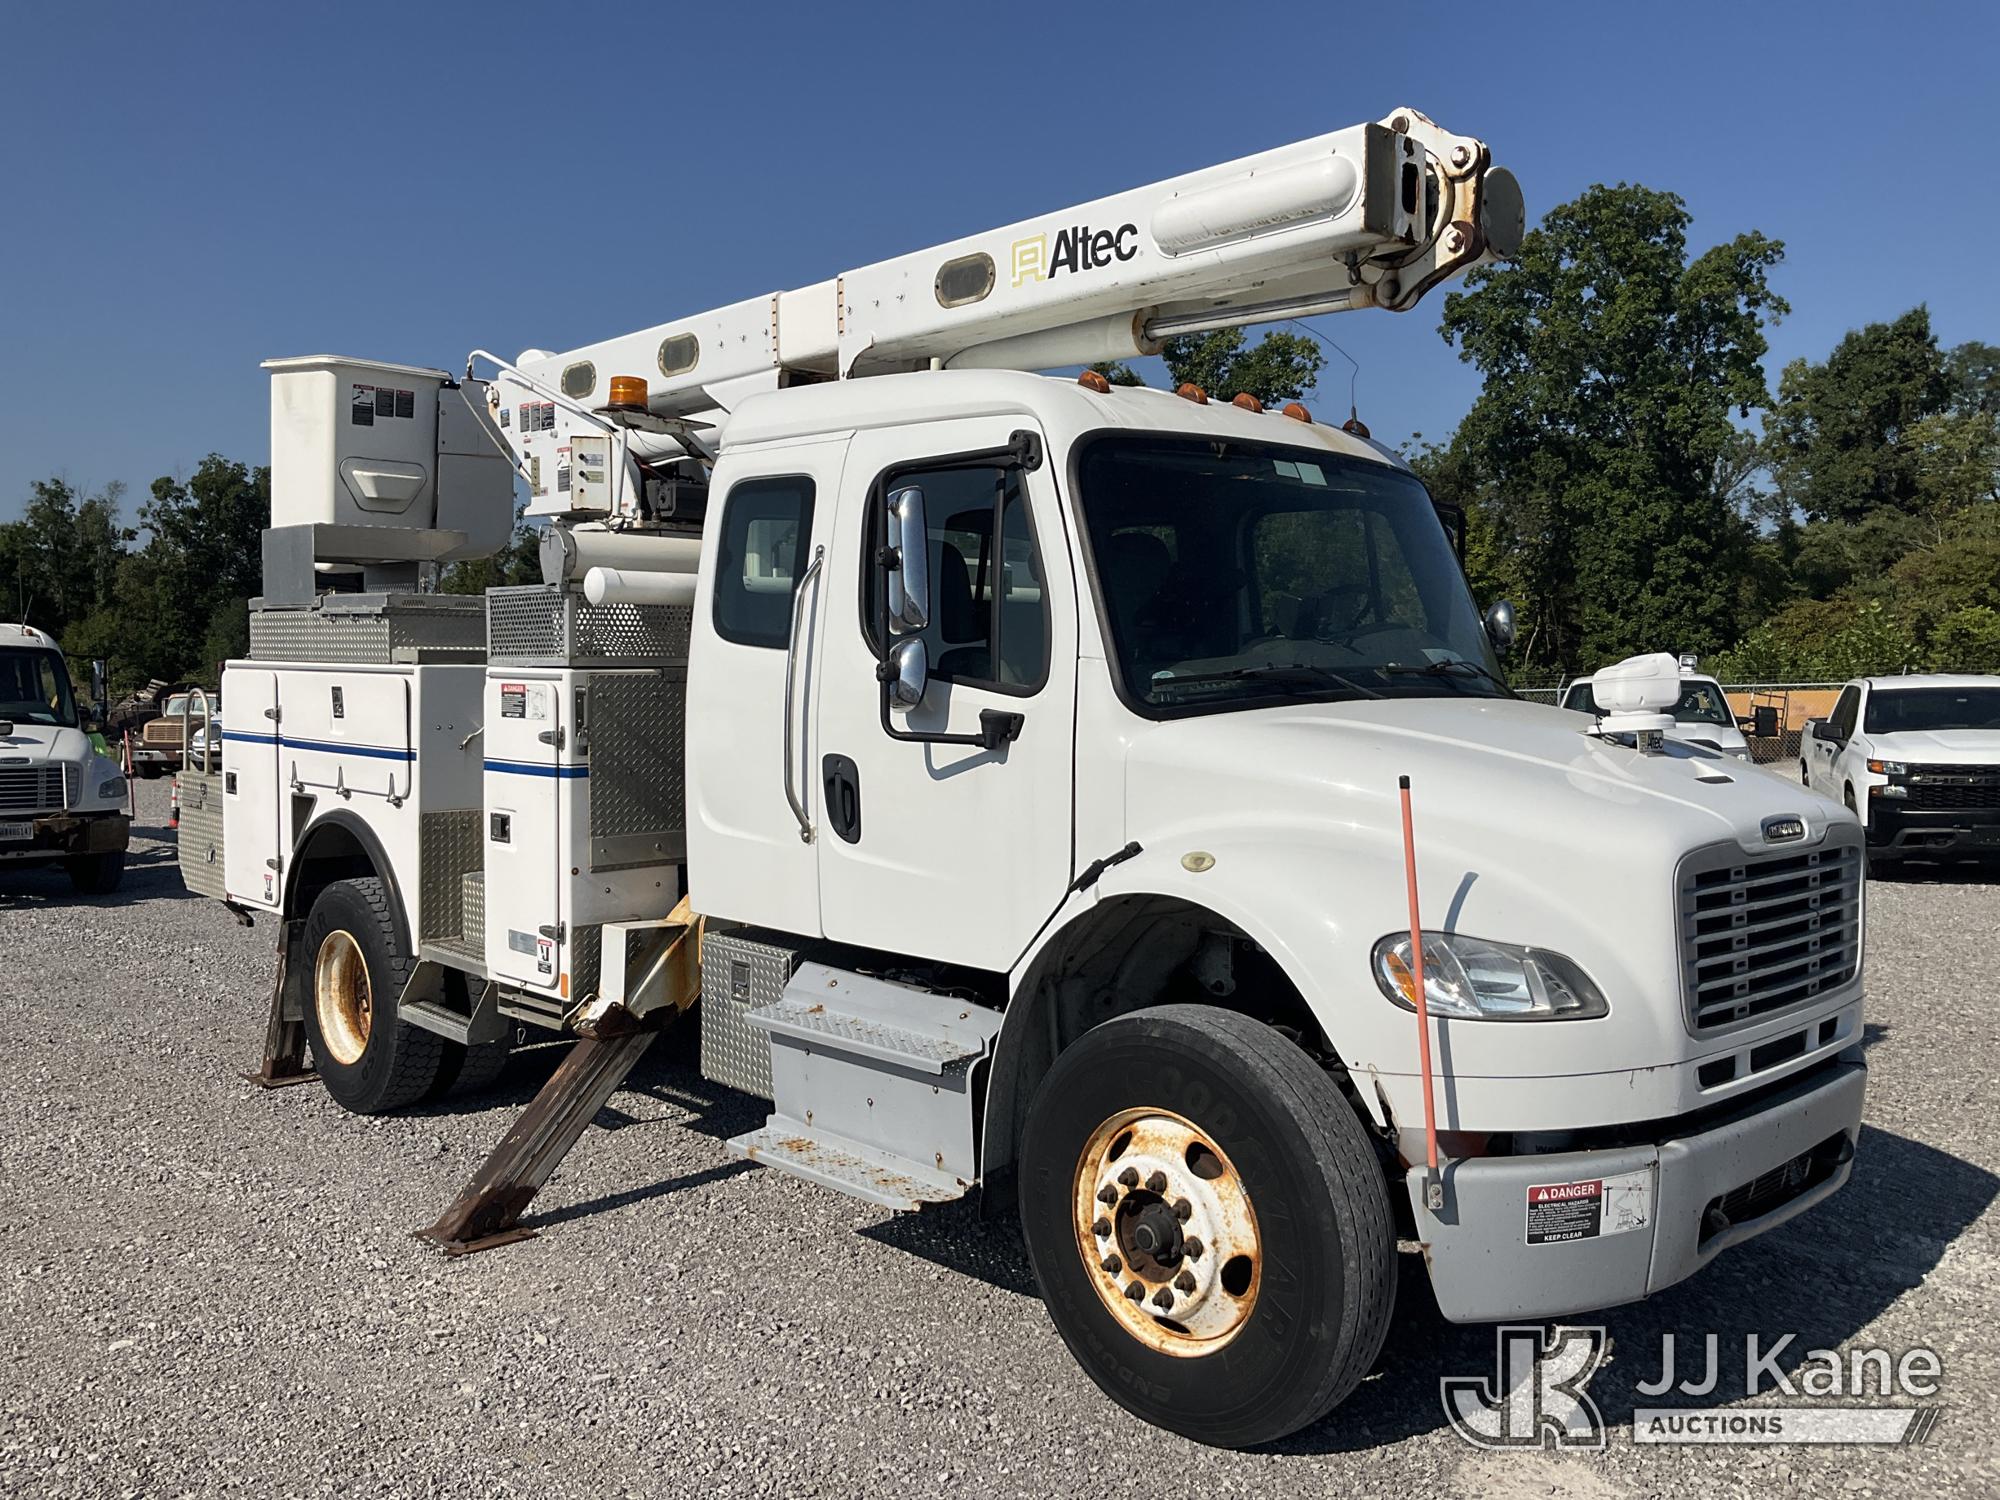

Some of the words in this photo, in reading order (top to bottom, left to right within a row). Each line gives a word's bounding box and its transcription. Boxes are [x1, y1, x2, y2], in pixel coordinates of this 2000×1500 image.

[1048, 223, 1138, 279] Altec
[1550, 1184, 1595, 1199] DANGER
[1544, 1233, 1562, 1242] KEEP
[1562, 1231, 1583, 1240] CLEAR
